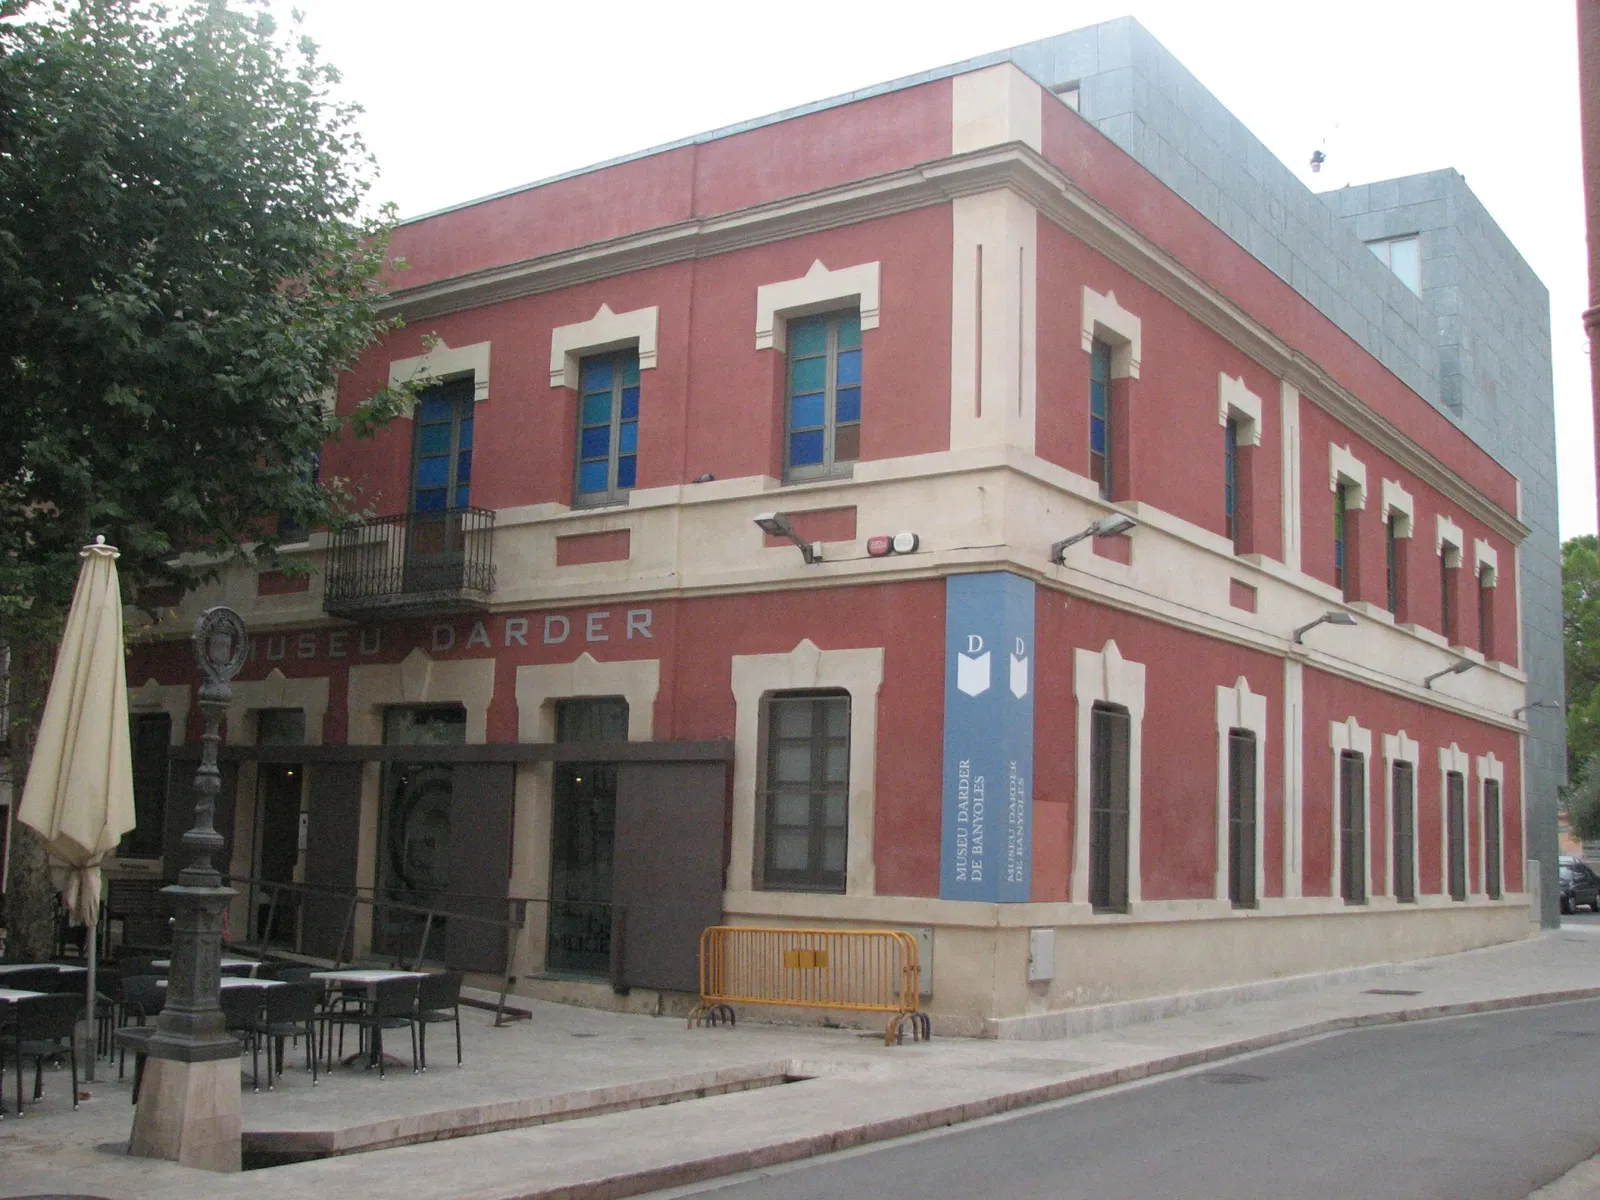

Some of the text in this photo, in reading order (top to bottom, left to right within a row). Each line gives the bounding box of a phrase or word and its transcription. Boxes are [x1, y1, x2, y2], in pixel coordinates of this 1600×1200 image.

[250, 628, 381, 661] USEU
[432, 609, 653, 651] DARDER
[967, 634, 984, 653] D
[1015, 636, 1025, 655] D
[956, 759, 970, 881] MUSEU DARDER
[971, 776, 985, 881] DE BANYOLES
[1007, 761, 1017, 882] MUSEU DARDER
[1016, 778, 1025, 882] DE BANYOLES
